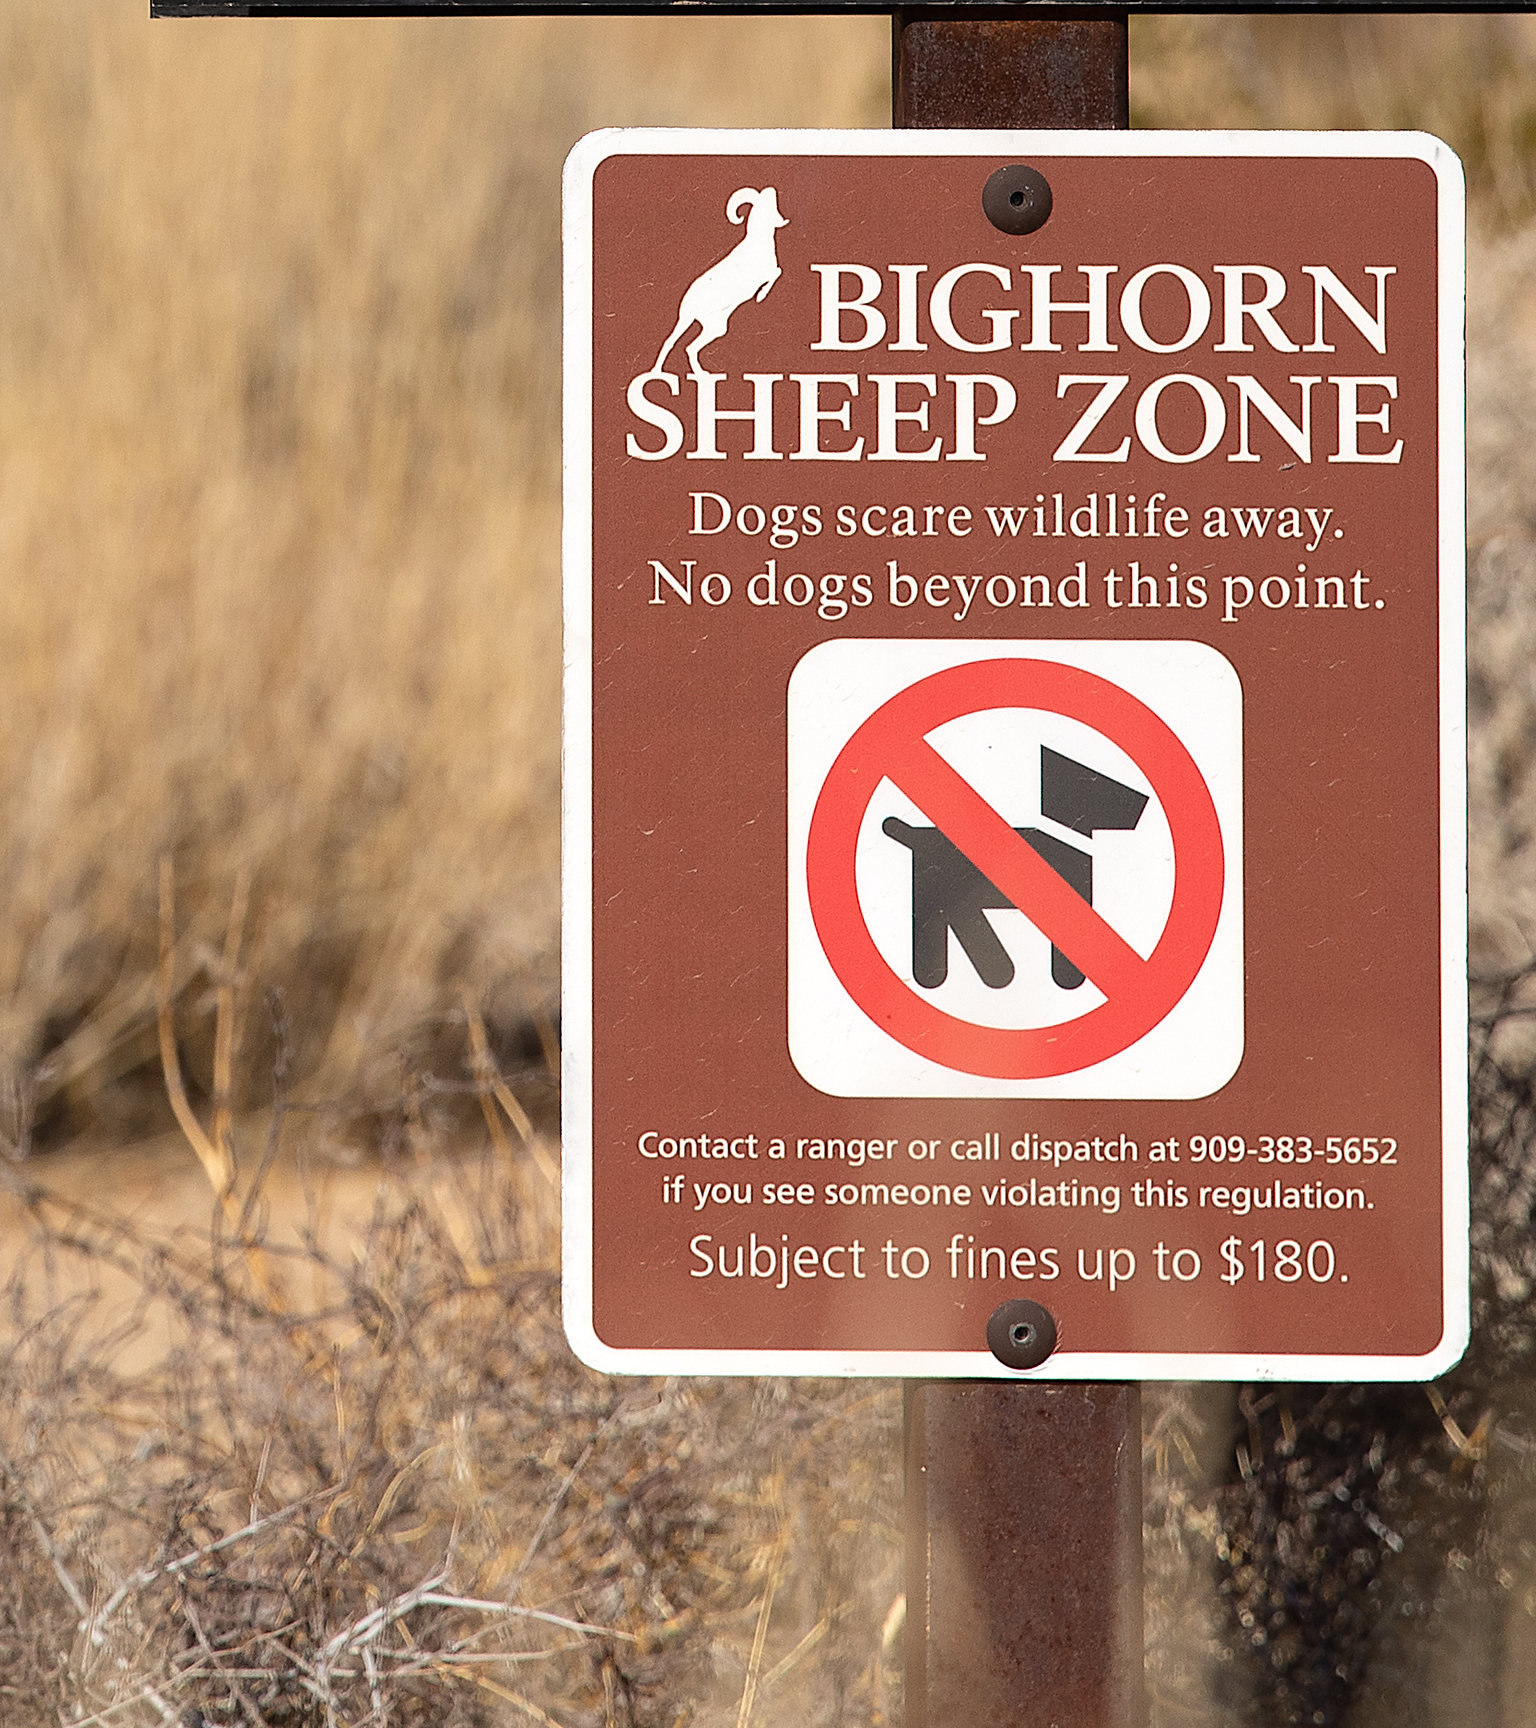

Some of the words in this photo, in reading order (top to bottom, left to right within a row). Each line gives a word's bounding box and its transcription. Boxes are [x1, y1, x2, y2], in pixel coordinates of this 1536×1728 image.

[810, 263, 1397, 354] BIGHORN
[626, 371, 1017, 461] SHEEP
[1052, 373, 1404, 464] ZONE
[688, 492, 822, 549] Dogs
[836, 505, 972, 537] scare
[984, 492, 1189, 538] wildlife
[1203, 506, 1344, 552] away.
[647, 560, 731, 606] No
[747, 559, 873, 621] dogs
[886, 560, 1090, 621] beyond
[1103, 561, 1208, 608] this
[1221, 563, 1385, 622] point.
[638, 1131, 759, 1159] Contact
[768, 1138, 785, 1159] a
[797, 1138, 899, 1167] ranger
[908, 1139, 942, 1160] or
[950, 1132, 1000, 1161] call
[1011, 1132, 1138, 1168] dispatch
[1148, 1137, 1180, 1162] at
[1189, 1135, 1398, 1164] 909-383-5652
[663, 1174, 685, 1204] if
[693, 1183, 752, 1211] you
[762, 1183, 815, 1205] see
[825, 1184, 972, 1206] someone
[981, 1178, 1120, 1214] violating
[1130, 1178, 1189, 1208] this
[1199, 1179, 1374, 1215] regulation.
[690, 1232, 866, 1289] Subject
[881, 1239, 930, 1279] to
[945, 1233, 1060, 1280] fines
[1078, 1248, 1136, 1292] up
[1152, 1241, 1201, 1281] to
[1220, 1235, 1348, 1286] $180.
